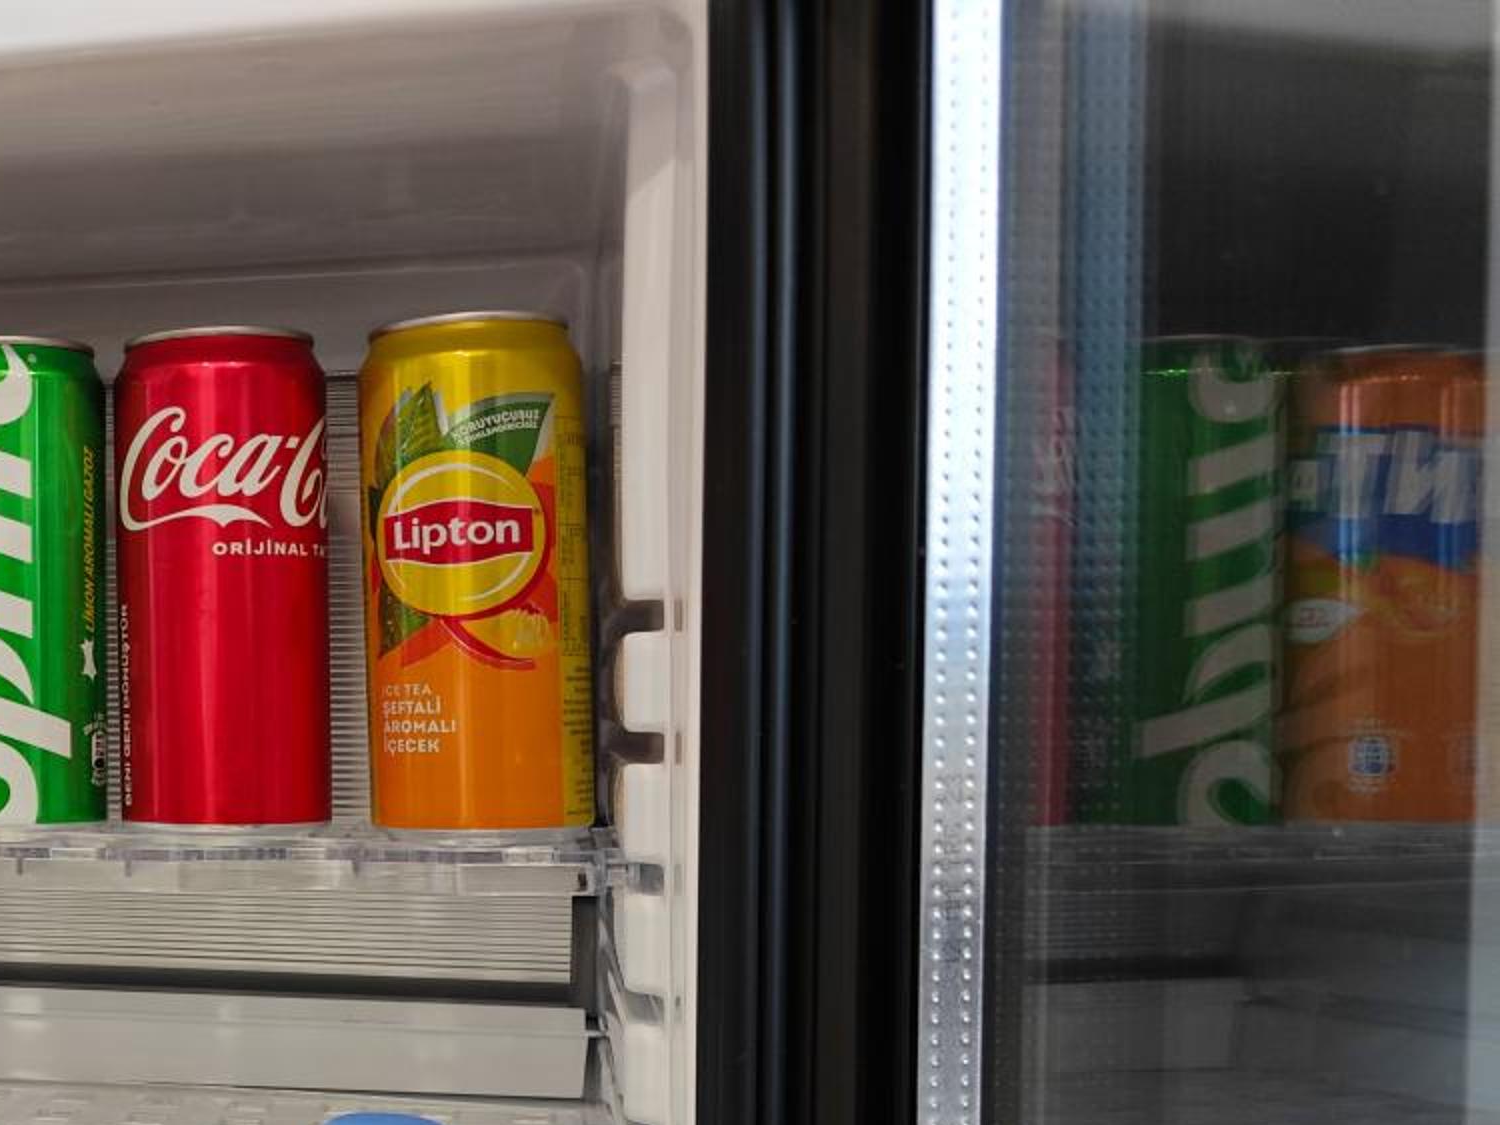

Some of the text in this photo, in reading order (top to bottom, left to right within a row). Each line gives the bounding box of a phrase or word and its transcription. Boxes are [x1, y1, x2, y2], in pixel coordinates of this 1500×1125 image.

[83, 503, 95, 577] AROMALI
[393, 515, 520, 555] Lipton
[212, 538, 308, 556] ORİJİNAL
[404, 683, 432, 696] TEA
[383, 719, 457, 733] AROMALI
